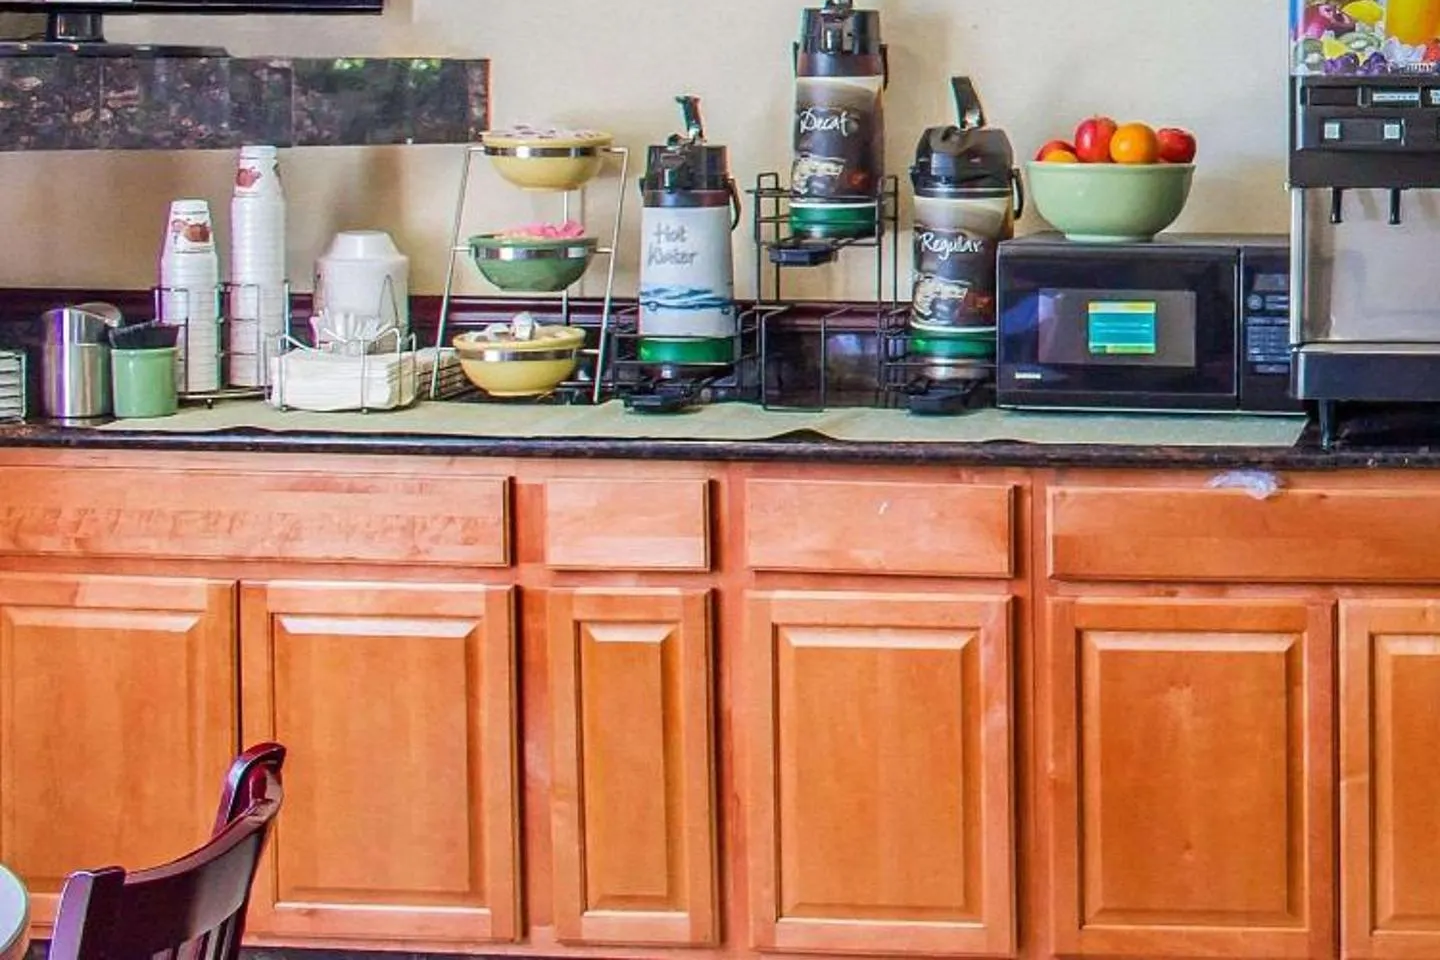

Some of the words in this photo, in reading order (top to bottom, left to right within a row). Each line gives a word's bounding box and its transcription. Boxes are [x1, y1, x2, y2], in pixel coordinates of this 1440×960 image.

[800, 107, 849, 137] Decaf
[653, 222, 687, 244] Hot
[919, 232, 983, 260] Regular
[647, 243, 699, 268] Water
